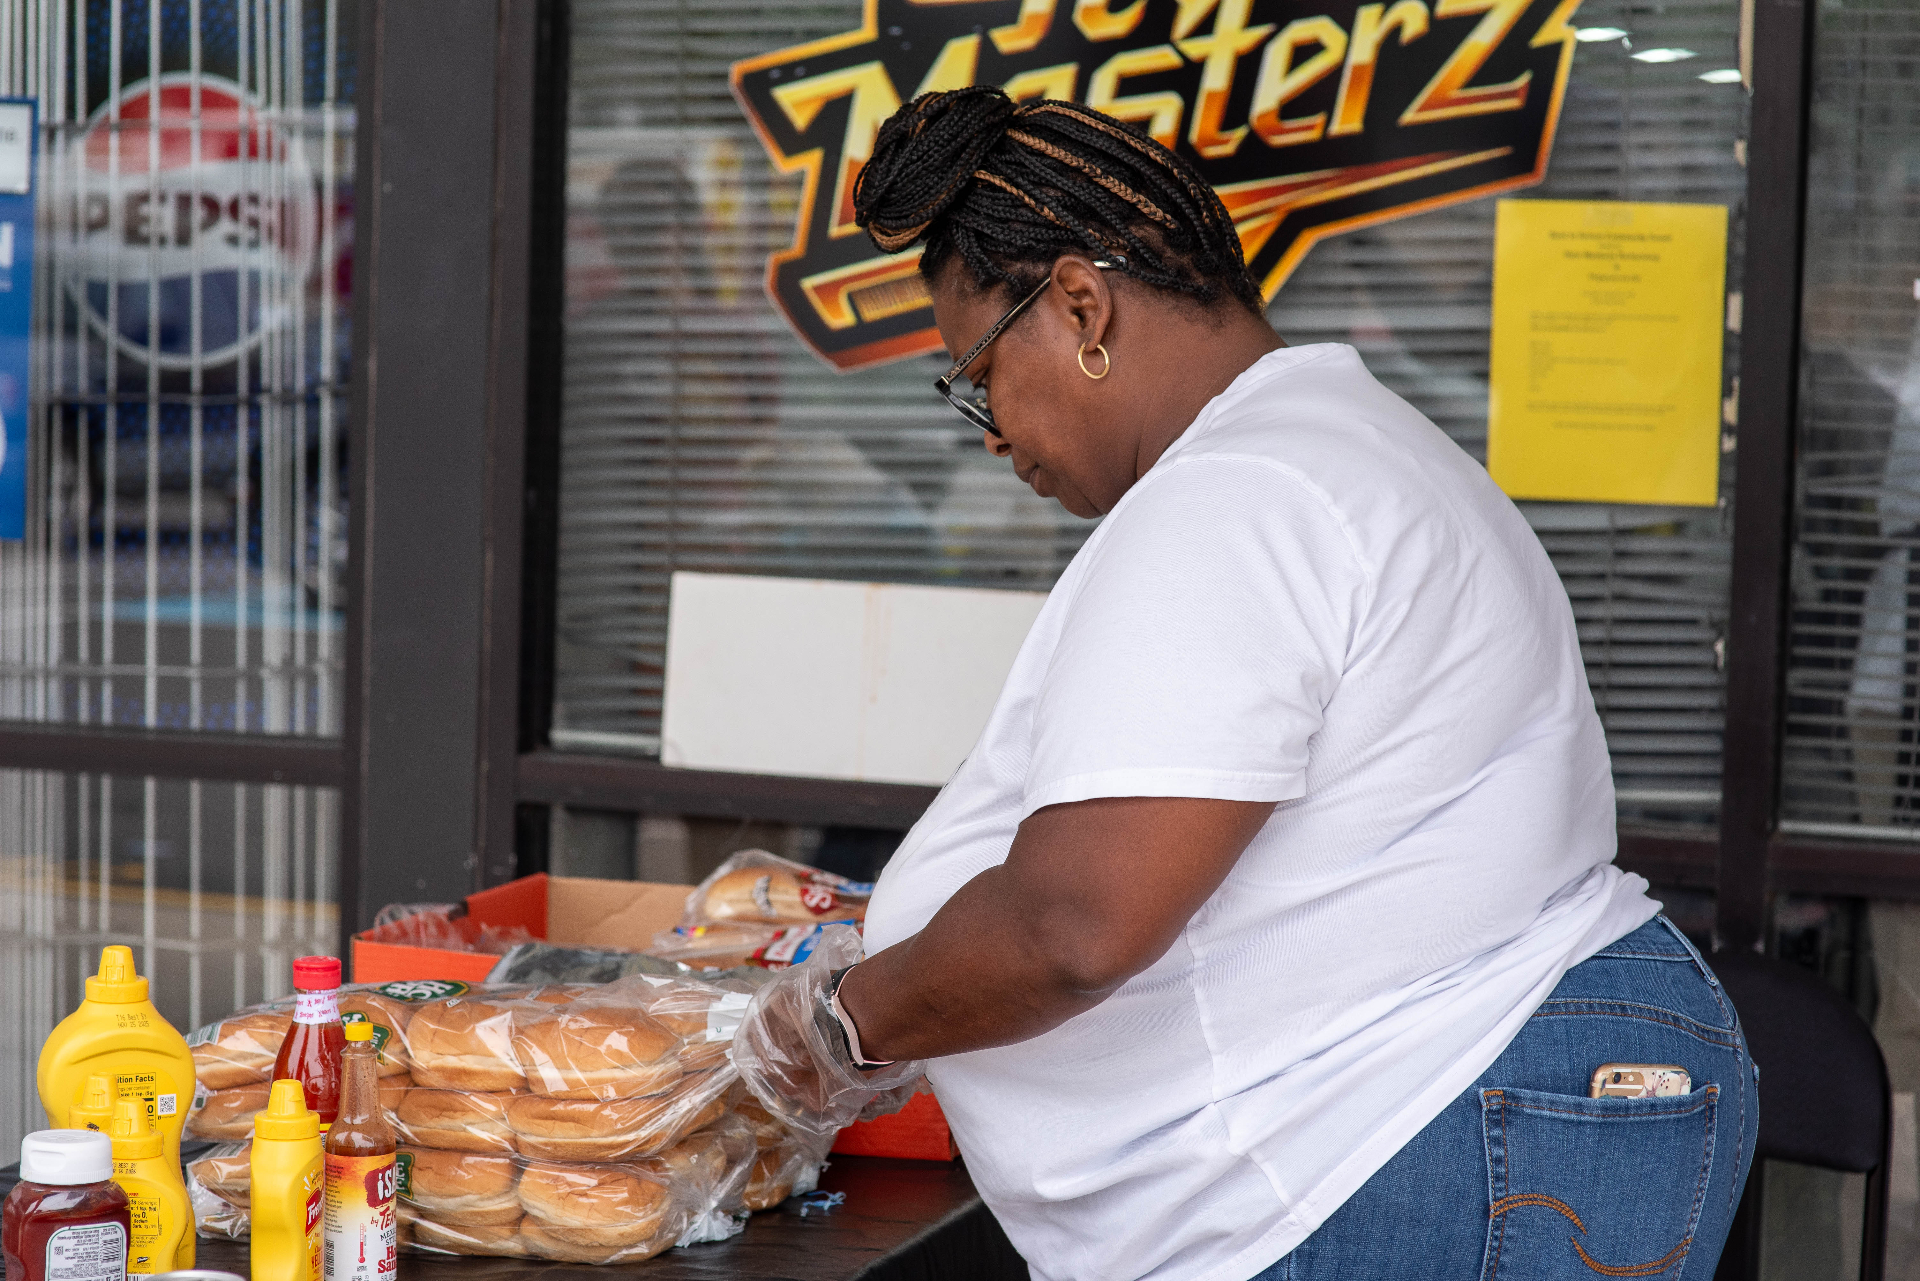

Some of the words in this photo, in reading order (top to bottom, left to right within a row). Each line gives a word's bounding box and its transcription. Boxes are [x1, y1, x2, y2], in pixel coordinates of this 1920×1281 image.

[70, 190, 292, 248] PEPS
[117, 1075, 133, 1083] ition
[135, 1074, 154, 1083] Facts
[370, 1216, 379, 1227] by
[377, 1258, 397, 1274] Sau
